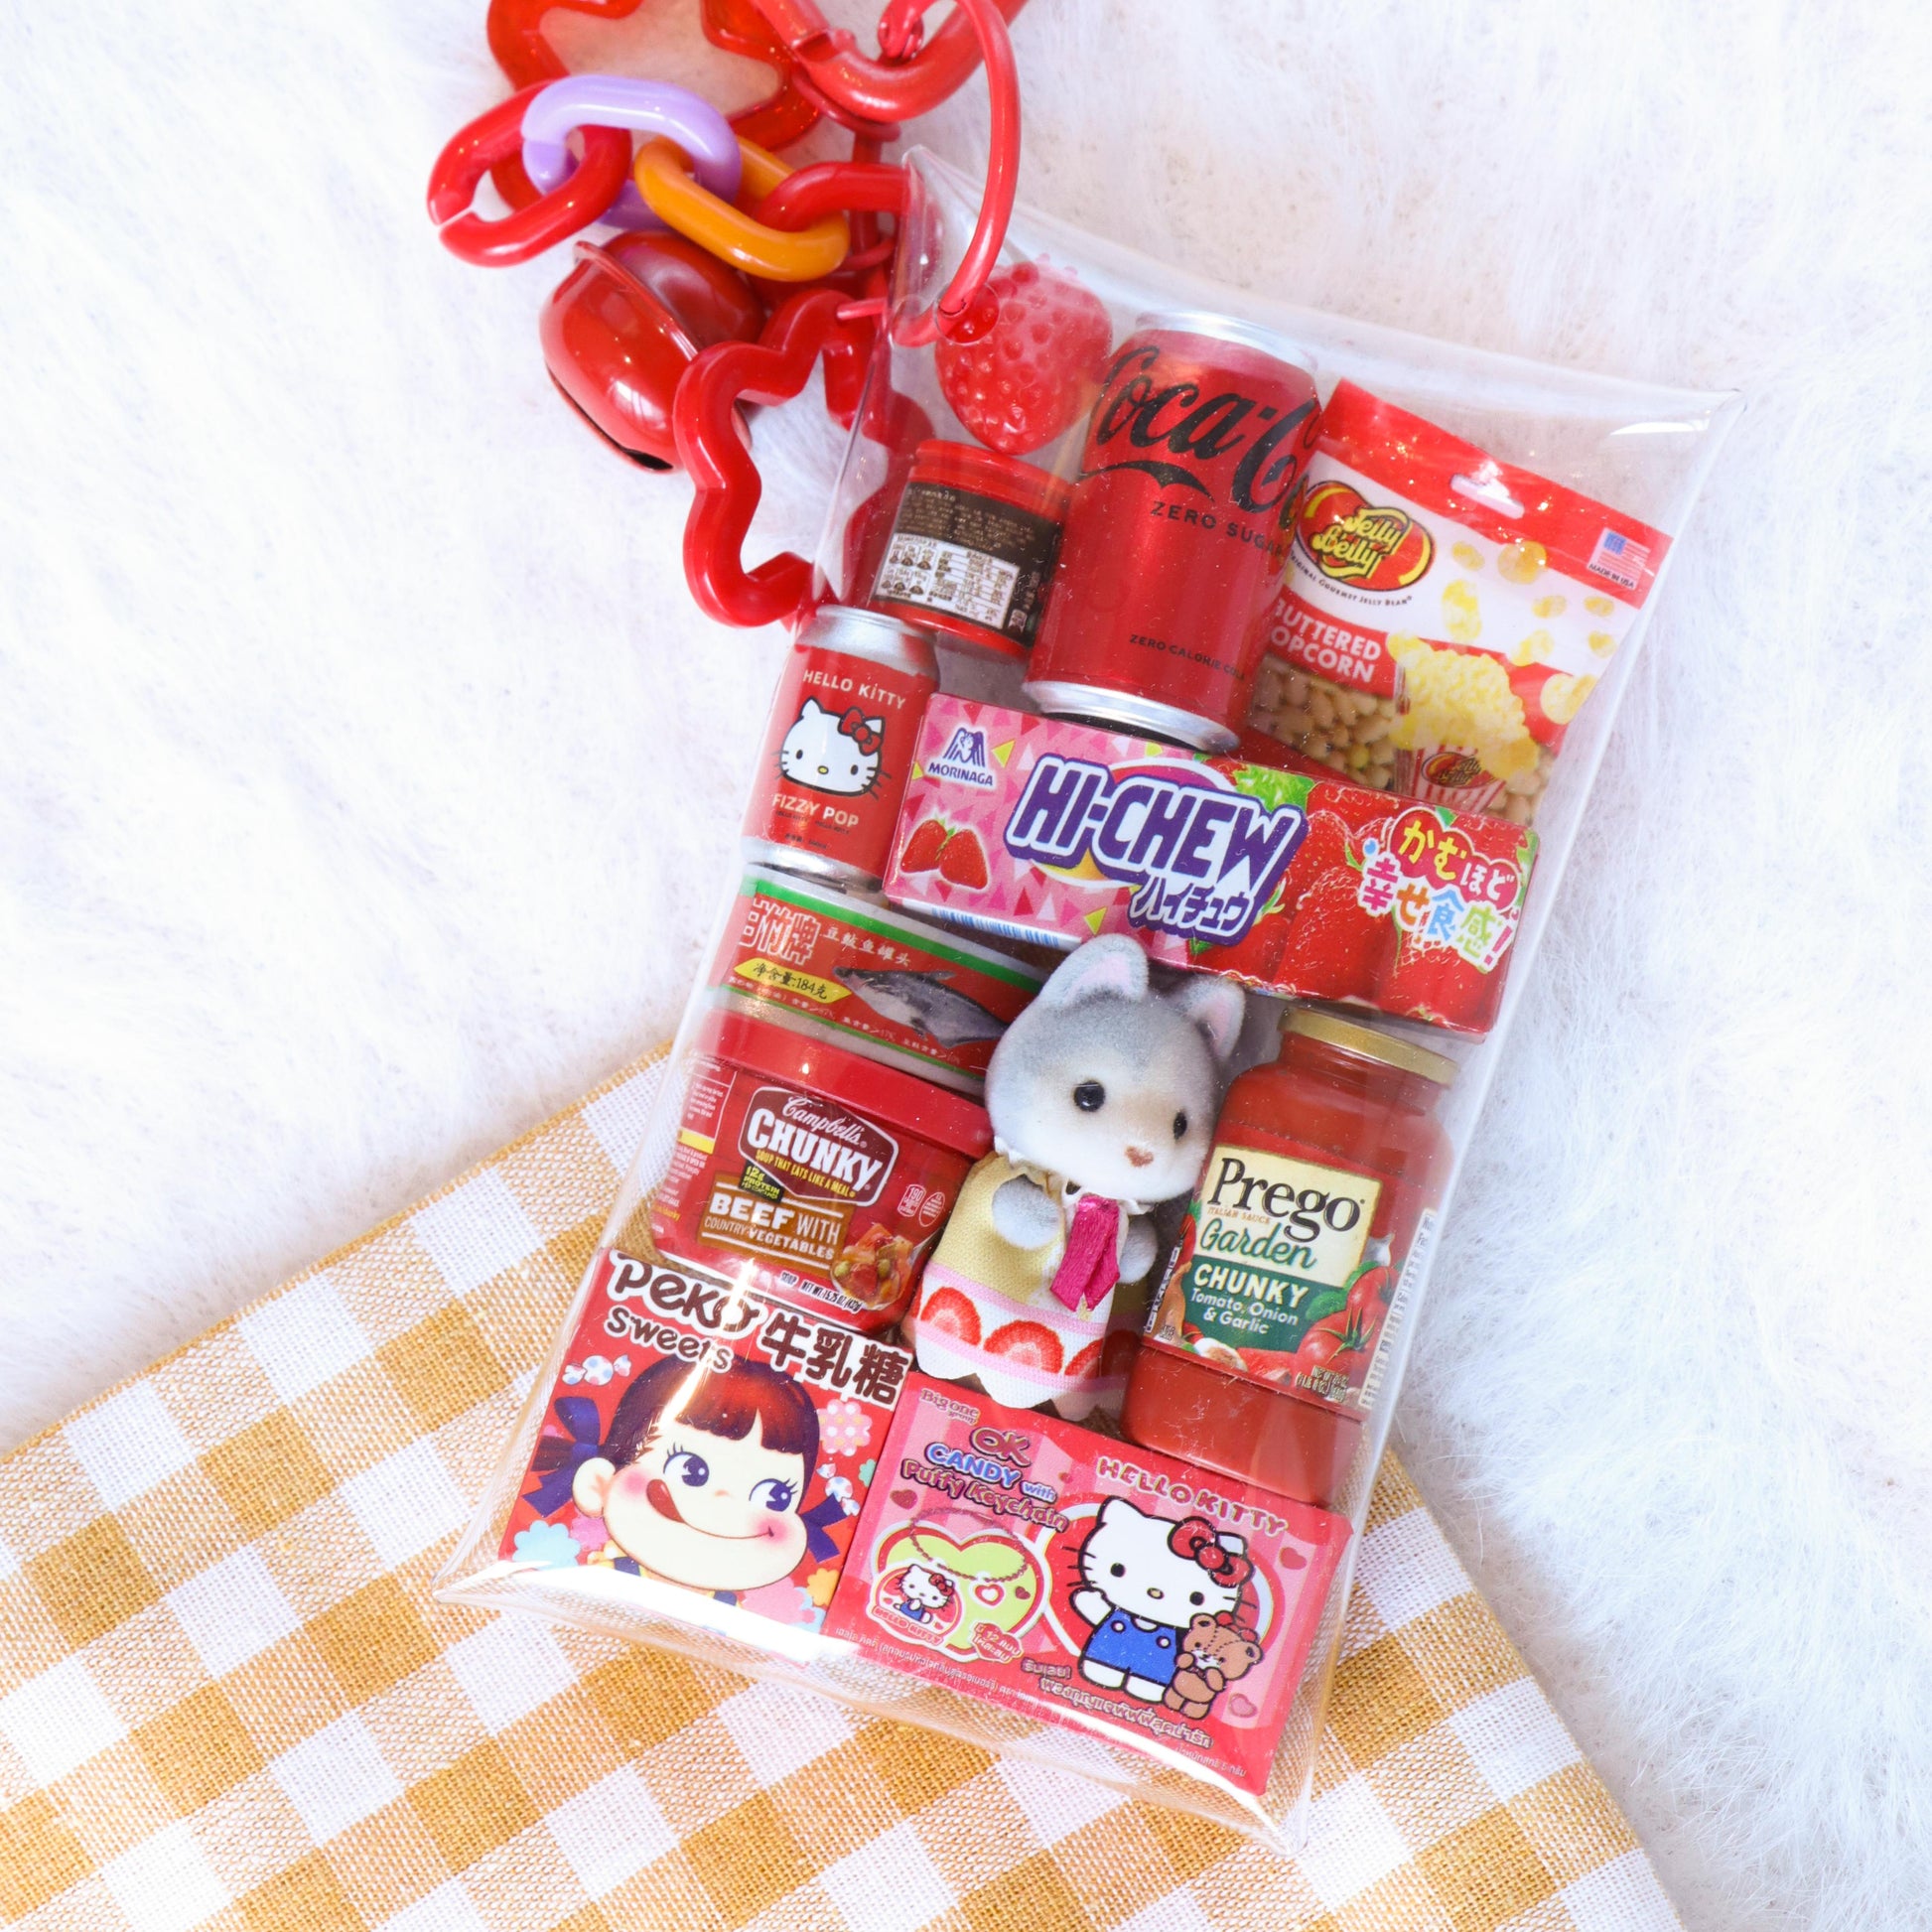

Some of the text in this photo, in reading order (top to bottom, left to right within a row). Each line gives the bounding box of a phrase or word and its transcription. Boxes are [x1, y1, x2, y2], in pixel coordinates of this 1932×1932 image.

[1150, 500, 1217, 530] ZERO
[1344, 507, 1410, 556] Jelly
[1311, 523, 1383, 579] Belly
[1588, 563, 1610, 576] MADE
[1620, 578, 1634, 588] USA
[1359, 597, 1382, 606] JELLY
[1130, 634, 1167, 651] ZERO
[1169, 644, 1222, 670] CALORIE
[1270, 625, 1375, 683] OPCORN
[803, 670, 854, 692] HELLO
[927, 761, 994, 787] MORINAGA
[771, 793, 860, 828] FIZZY POP
[1008, 758, 1304, 894] HI-CHEW
[1397, 819, 1516, 901] かむほど
[1131, 878, 1253, 936] ハイチュウ
[781, 1095, 863, 1147] Campbell's
[747, 1107, 884, 1192] CHUNKY
[744, 1175, 781, 1195] PROTEIN
[756, 1149, 851, 1197] SOUP THAT EATS LIKE A MEAL
[908, 1187, 924, 1201] 190
[709, 1192, 795, 1230] BEEF
[797, 1212, 842, 1246] WITH
[1207, 1157, 1361, 1242] Prego
[1207, 1207, 1271, 1225] ITALIAN SAUCE
[703, 1216, 835, 1261] COUNTRY VEGETABLES
[1200, 1218, 1317, 1271] Garden
[780, 1271, 798, 1286] SOUP
[1193, 1263, 1310, 1310] CHUNKY
[1203, 1307, 1270, 1335] & Garlic
[1248, 1301, 1299, 1326] Onion
[759, 1311, 909, 1406] 牛乳糖
[921, 1389, 980, 1419] Big one
[947, 1411, 977, 1425] group
[971, 1428, 1032, 1466] OK
[925, 1443, 1058, 1505] CANDY with
[900, 1458, 1070, 1534] Puffy Keychain
[1096, 1455, 1289, 1537] HELLO KITTY
[872, 1605, 945, 1647] HELLO KITTY
[986, 1629, 1000, 1643] 12
